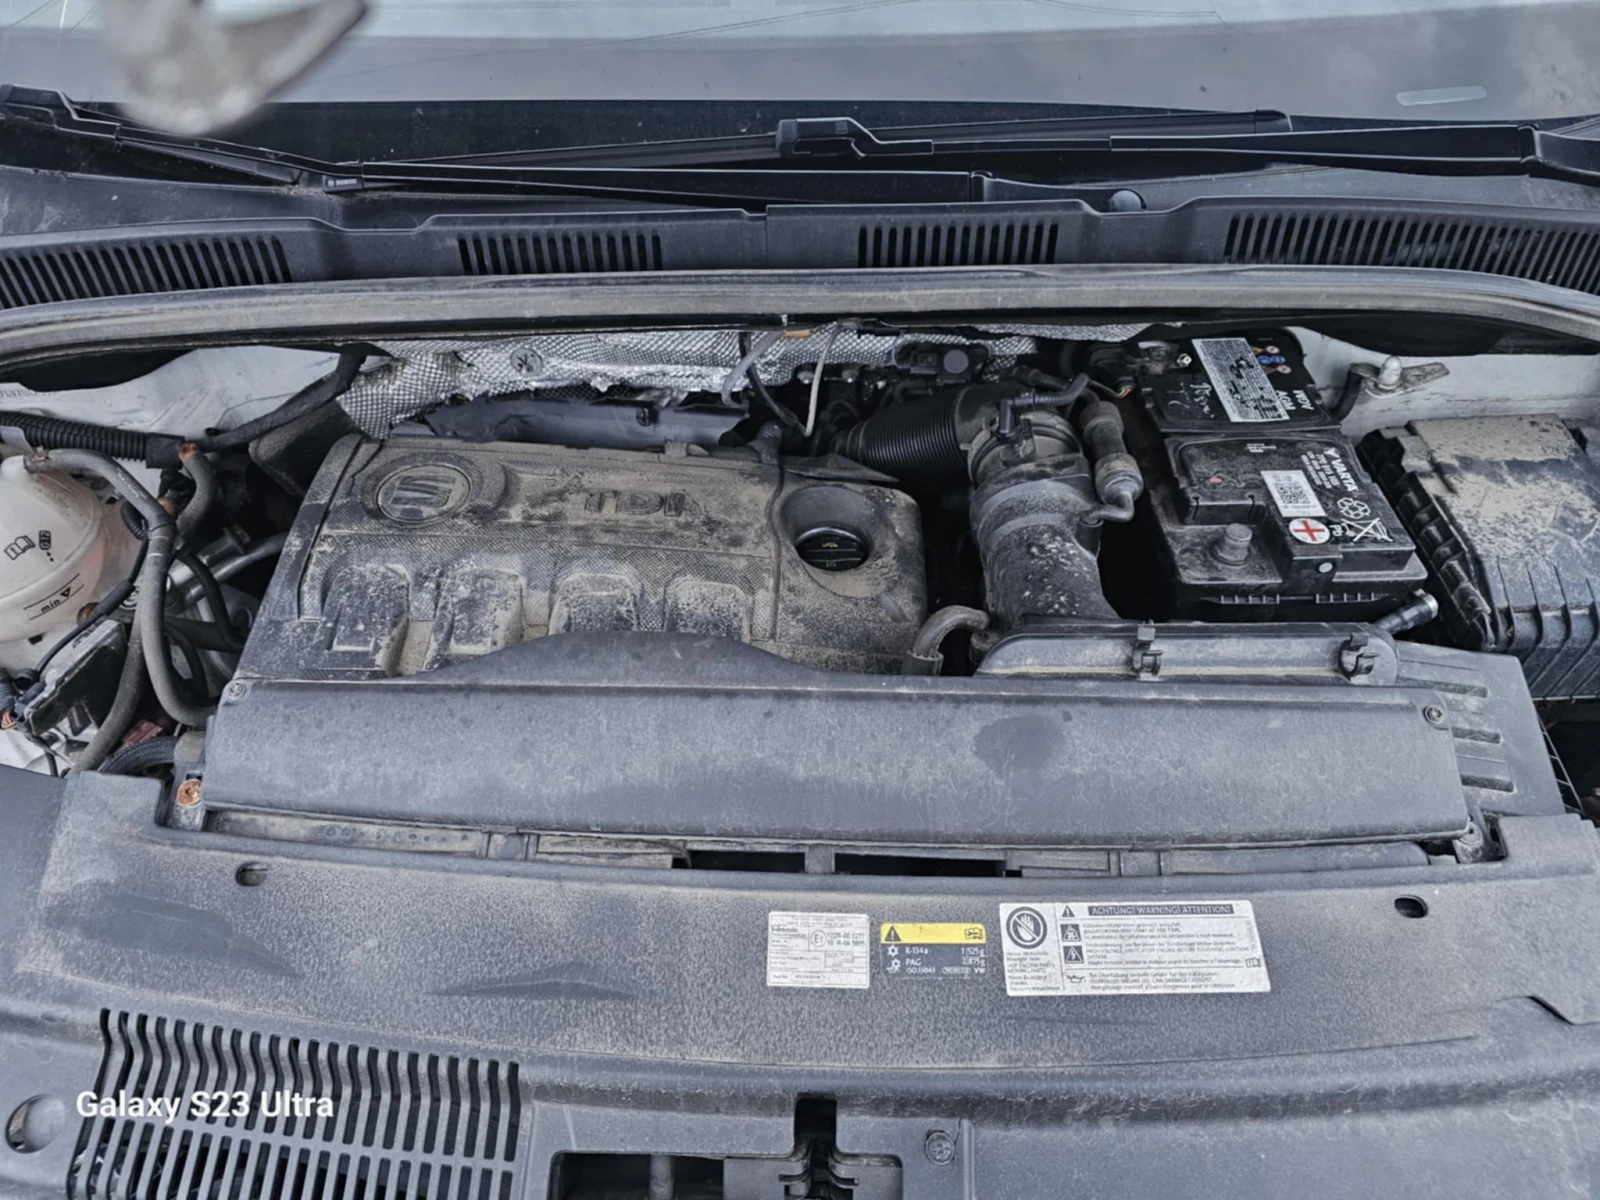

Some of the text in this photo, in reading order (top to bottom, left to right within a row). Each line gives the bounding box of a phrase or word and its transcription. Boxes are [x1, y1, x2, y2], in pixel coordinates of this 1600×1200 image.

[1331, 458, 1359, 491] VARTA
[584, 490, 687, 517] TDI
[40, 598, 61, 614] min
[1091, 904, 1231, 915] ACHTUNG! WARNING! ATTENTION!
[905, 957, 922, 966] PAG
